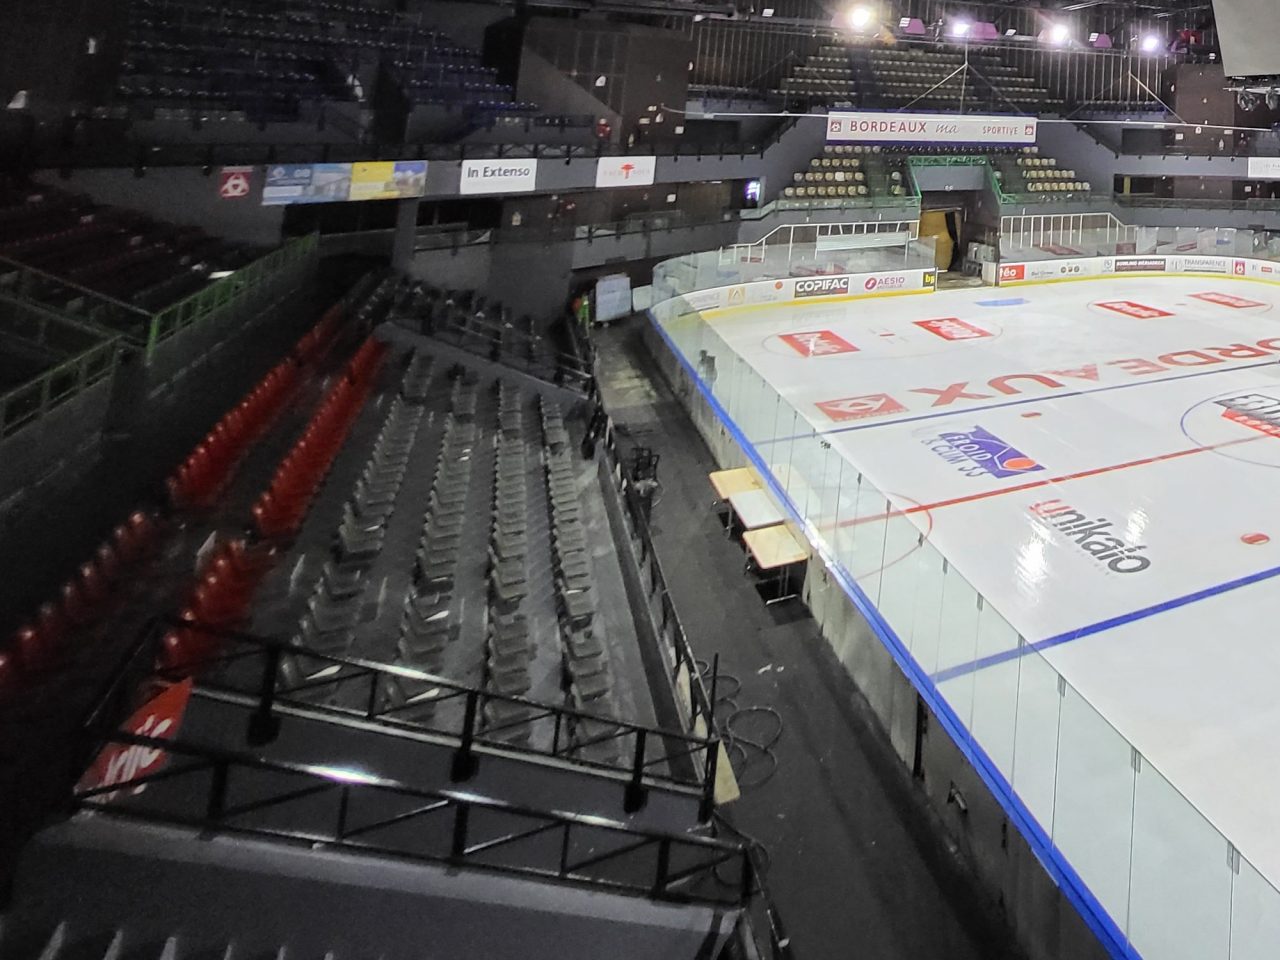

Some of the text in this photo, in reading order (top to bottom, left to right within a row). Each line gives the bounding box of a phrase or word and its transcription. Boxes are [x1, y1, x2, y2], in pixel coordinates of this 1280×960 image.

[850, 121, 928, 133] BORDEAUX
[982, 125, 1018, 136] SPORTIVE
[467, 166, 530, 178] In Extenso
[796, 277, 848, 292] COPIFAC
